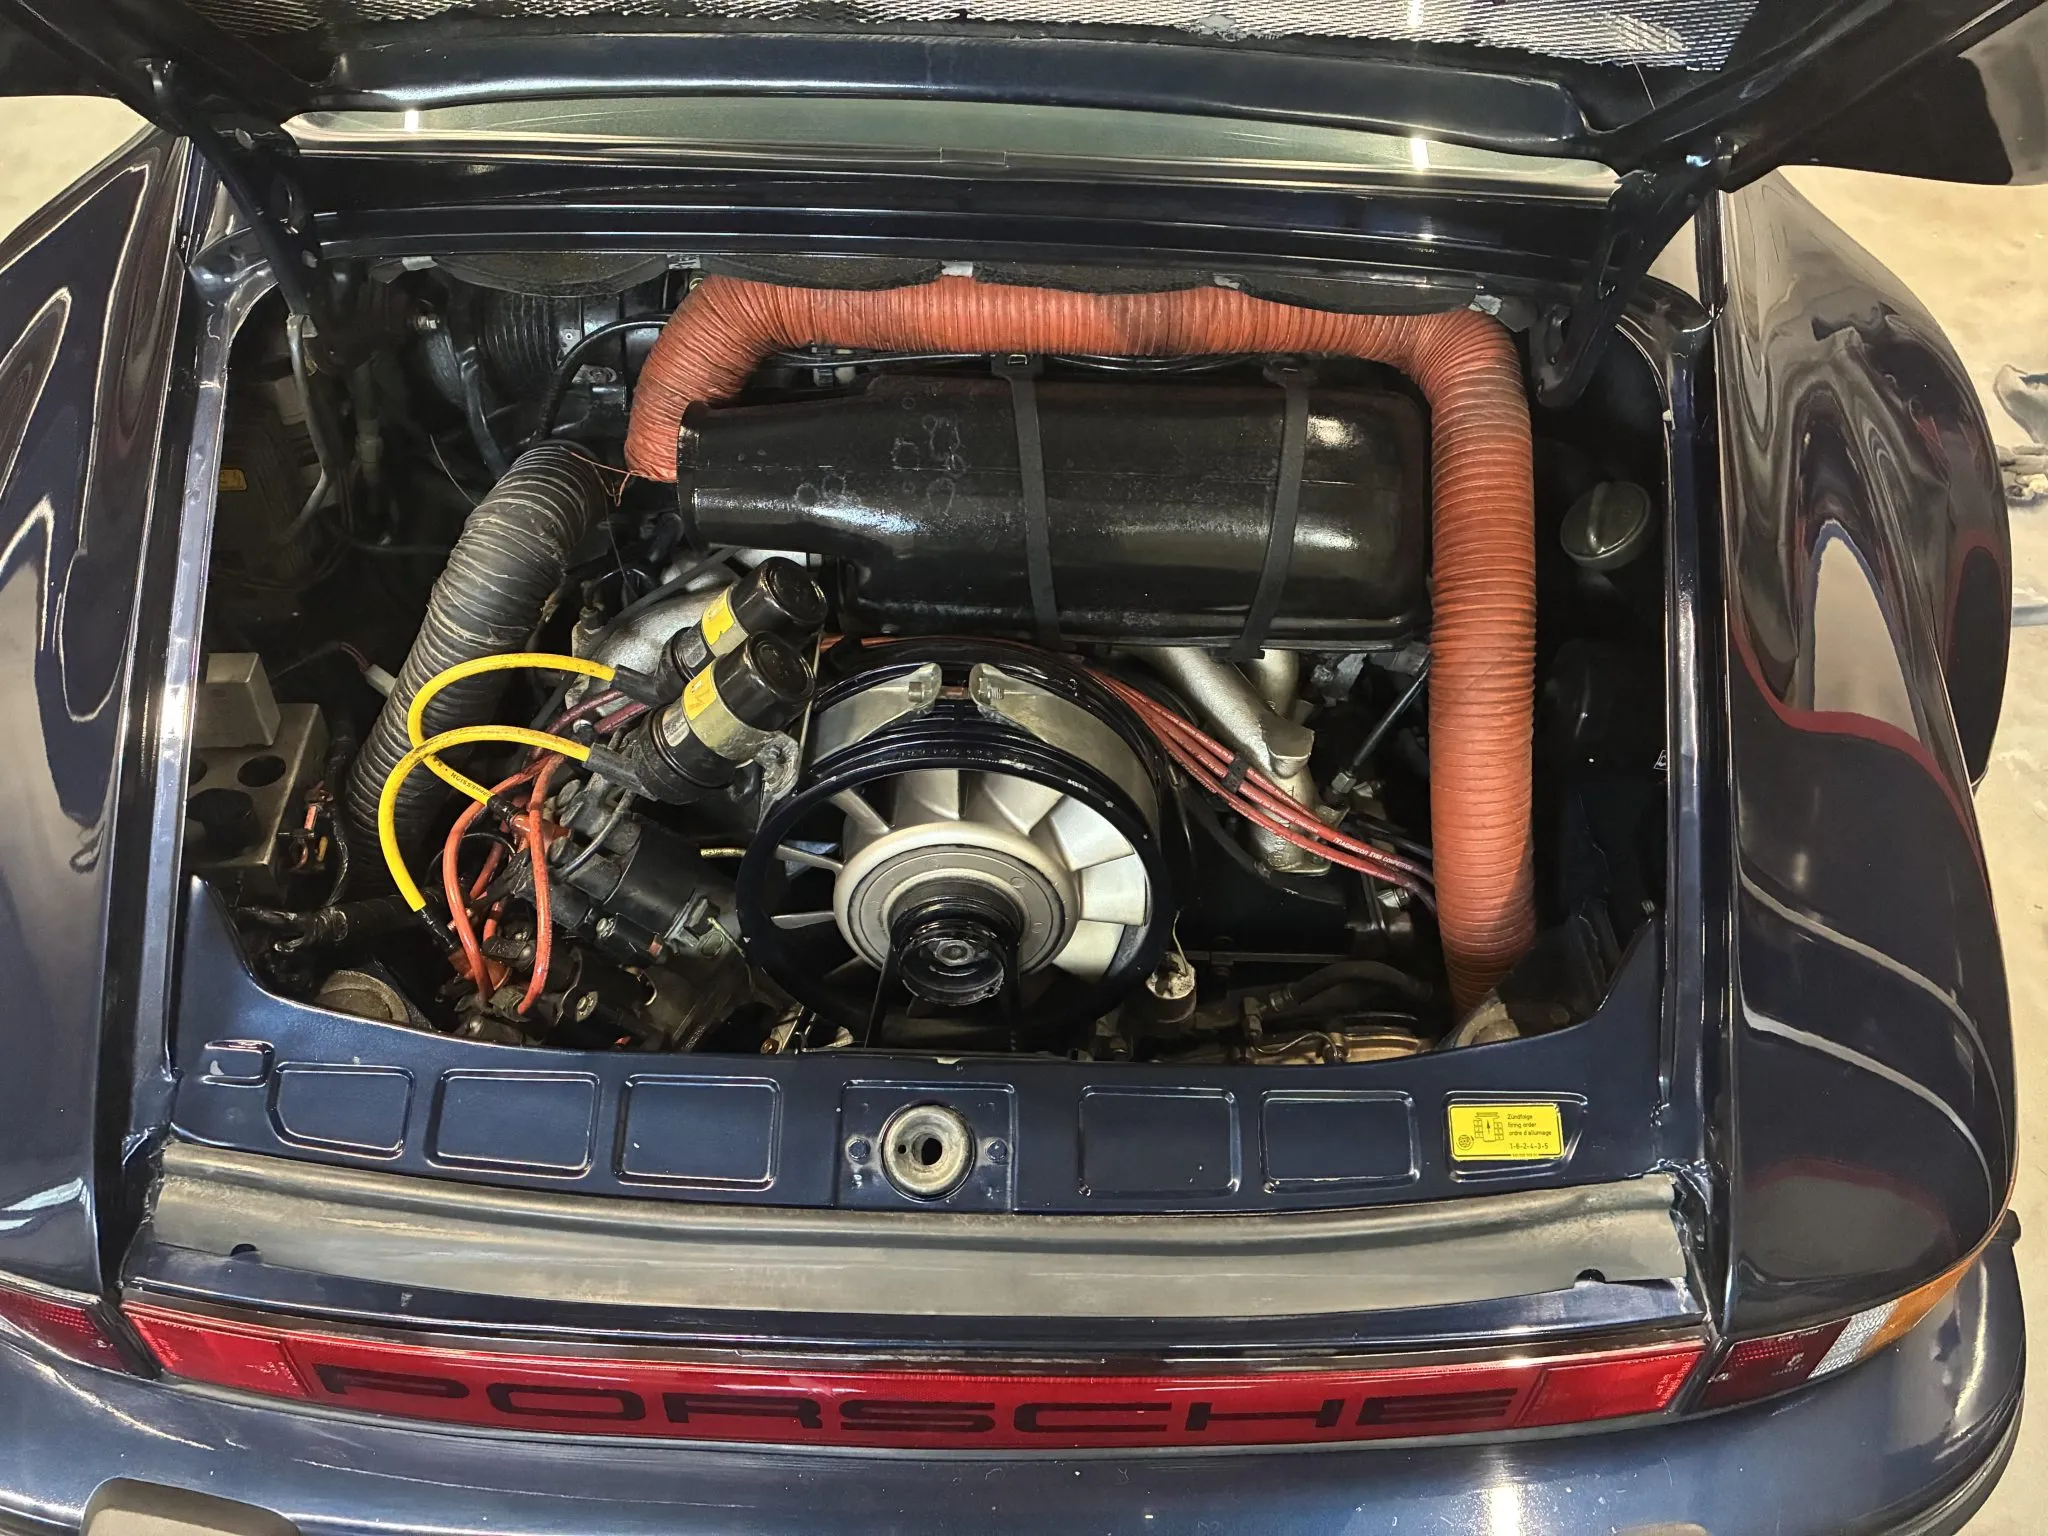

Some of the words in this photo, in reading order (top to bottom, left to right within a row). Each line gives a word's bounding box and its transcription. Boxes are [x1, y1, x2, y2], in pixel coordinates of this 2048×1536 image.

[450, 772, 492, 797] UPPRESSION
[1381, 855, 1413, 871] COMPETITION
[312, 1364, 1518, 1433] PORSCHE
